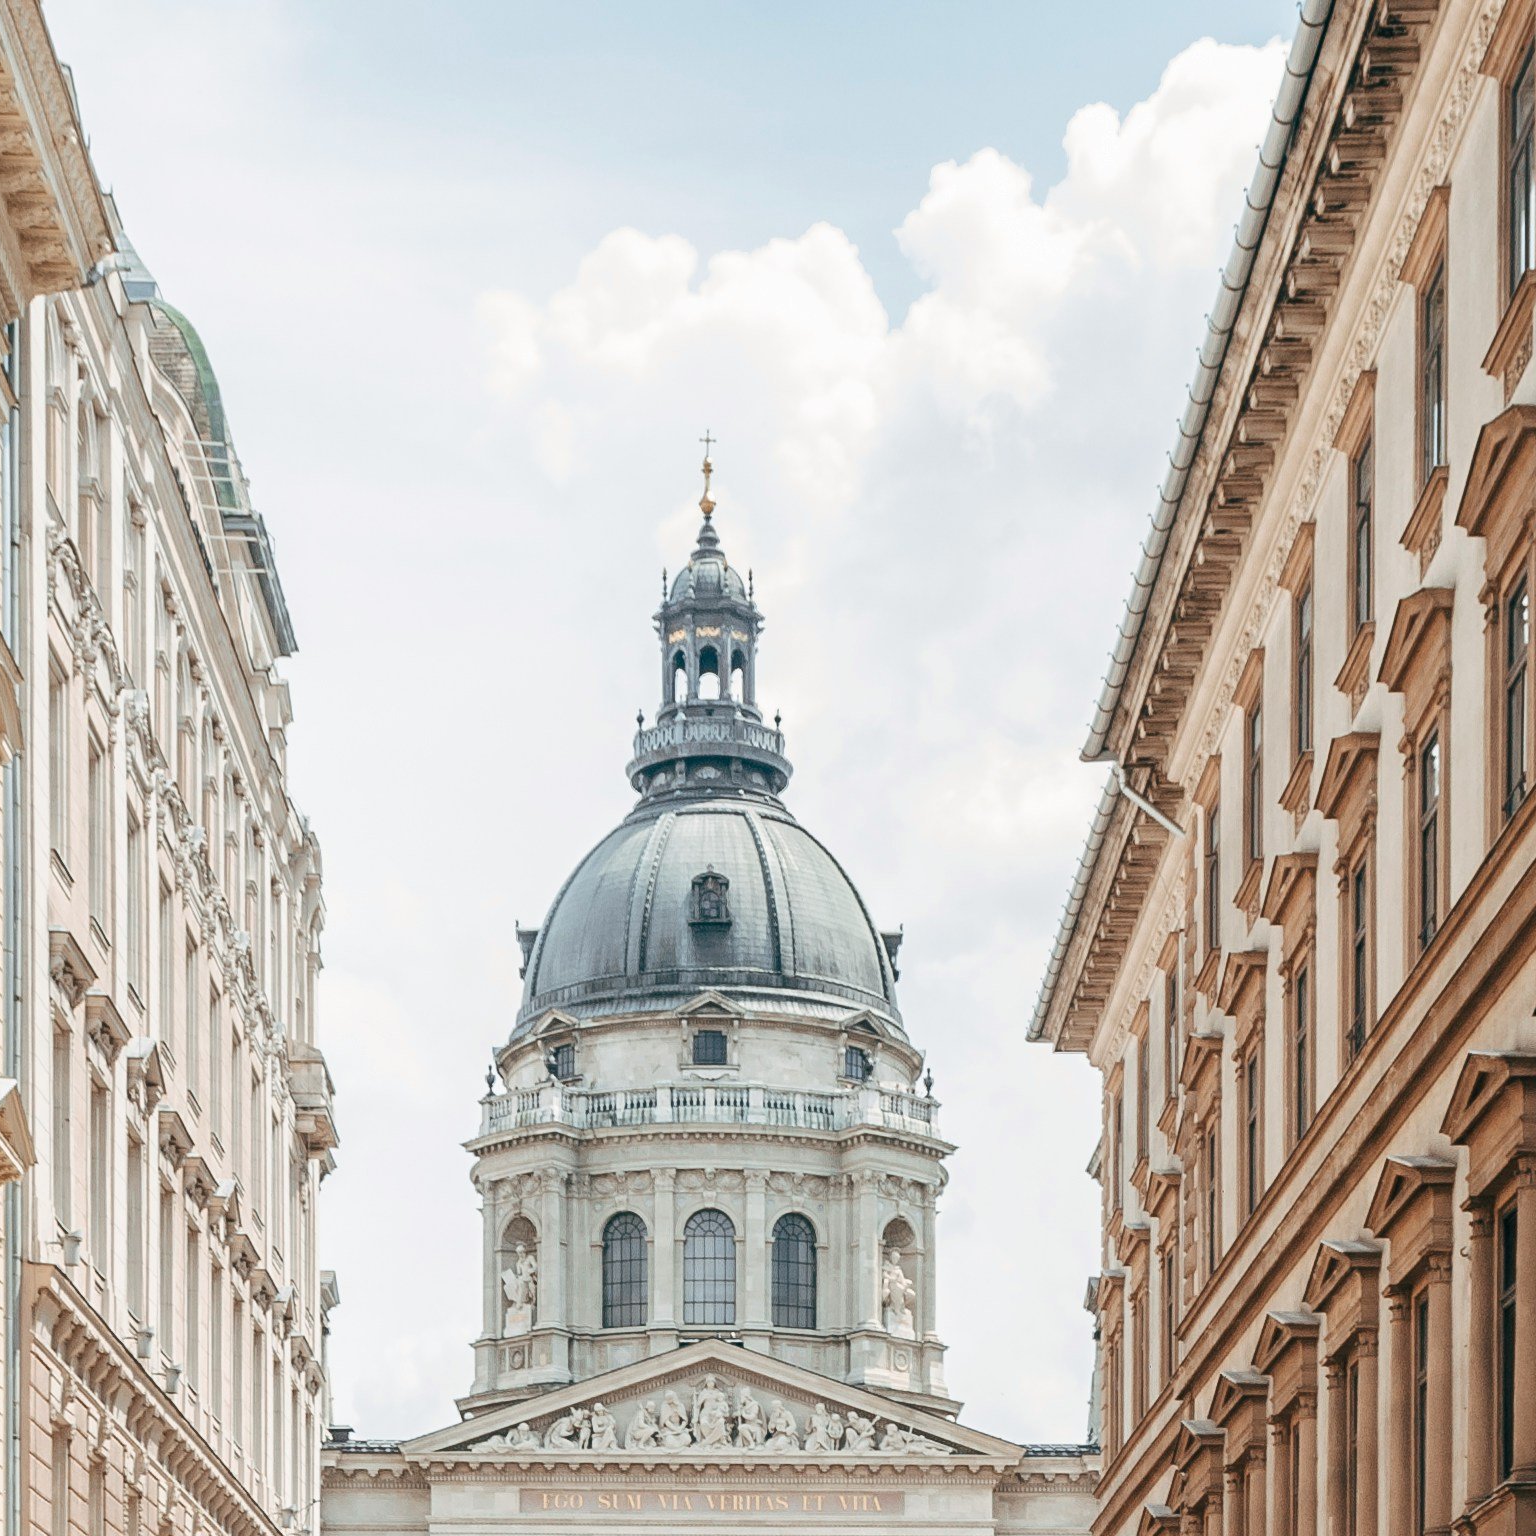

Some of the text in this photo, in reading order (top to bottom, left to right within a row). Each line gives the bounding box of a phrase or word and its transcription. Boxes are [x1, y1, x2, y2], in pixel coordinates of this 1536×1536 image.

[542, 1493, 882, 1511] EGO SUM VIA VERITAS ET VITA
